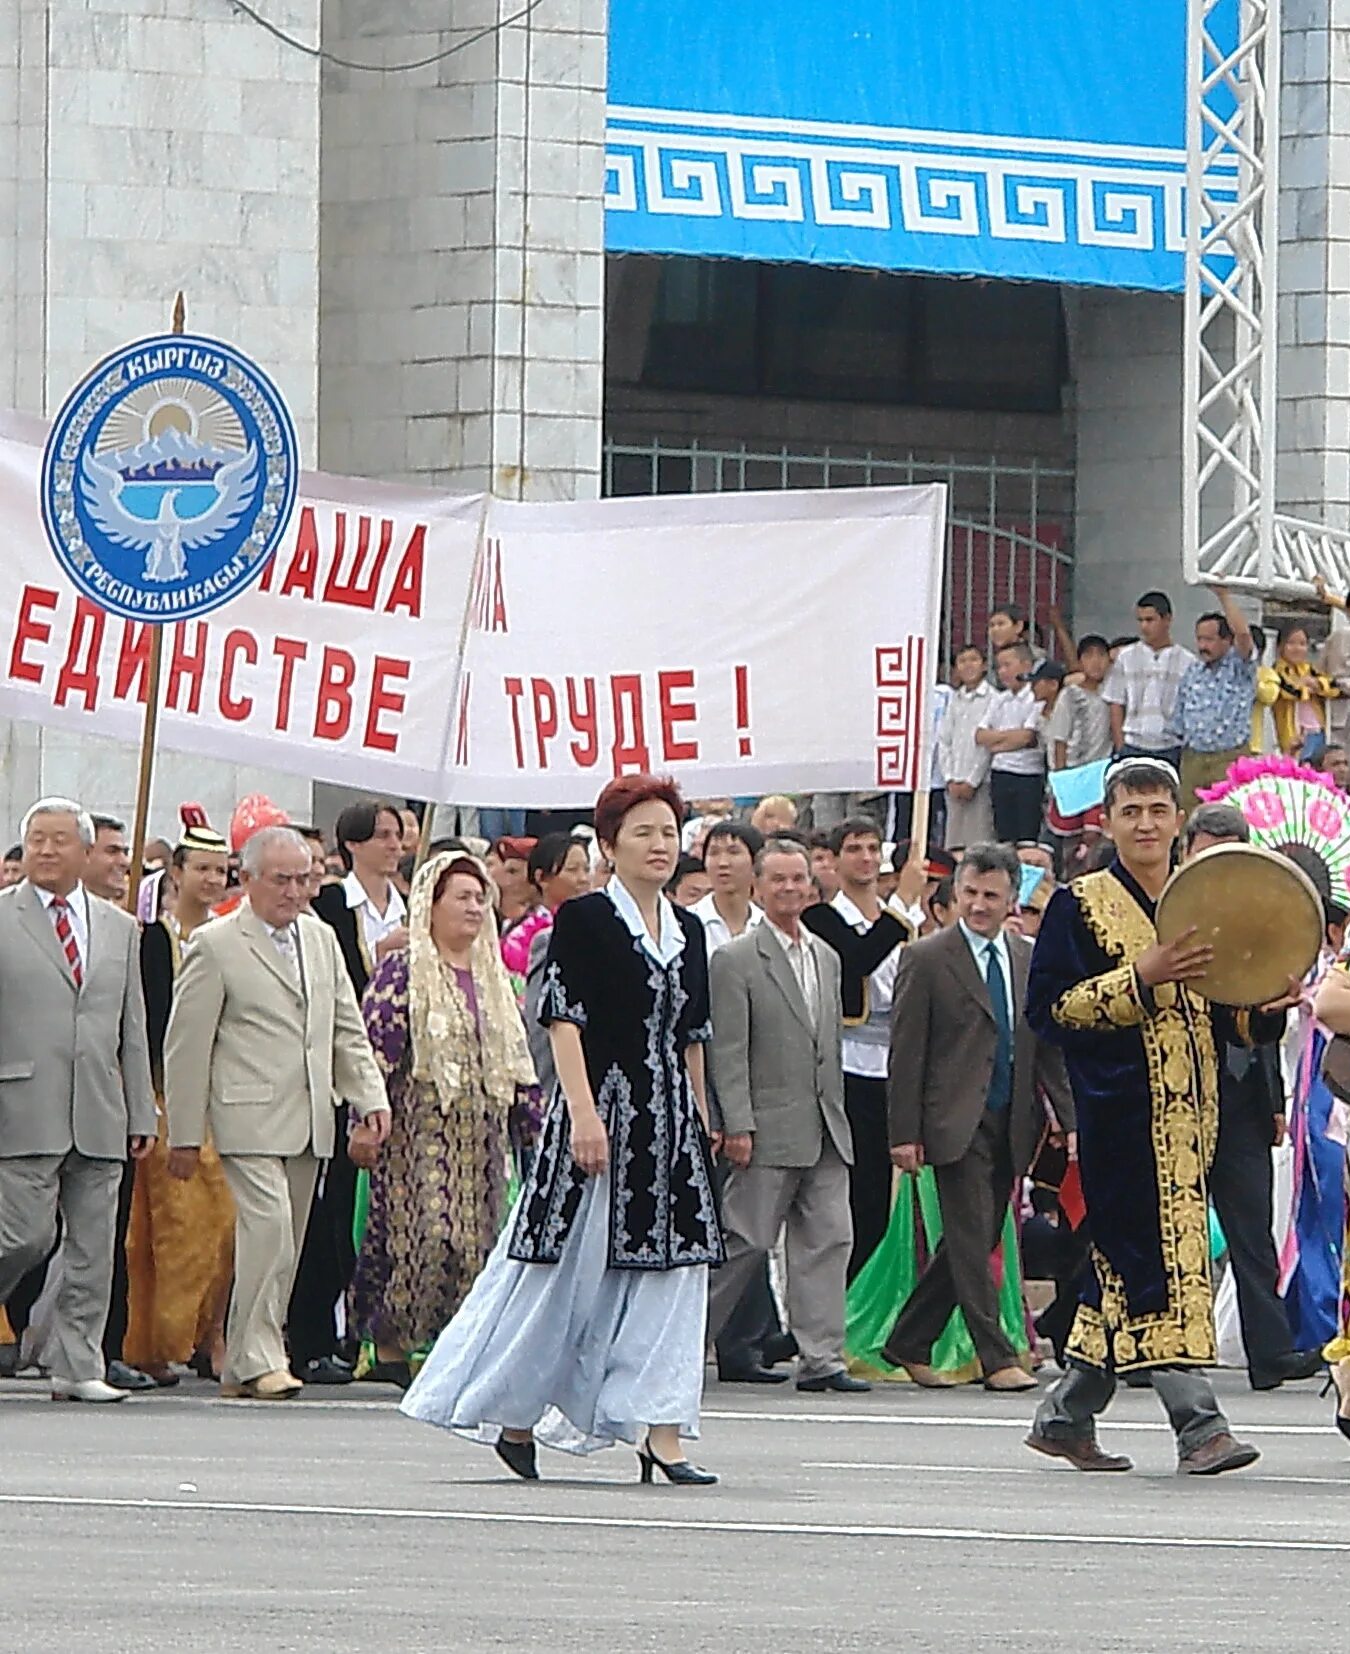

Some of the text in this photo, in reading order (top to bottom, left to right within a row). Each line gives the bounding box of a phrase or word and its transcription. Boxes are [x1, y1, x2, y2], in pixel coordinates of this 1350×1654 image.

[127, 347, 227, 381] КЫРГЫЗ
[84, 556, 247, 613] РЕСПУБЛИКАСЫ
[9, 584, 412, 753] ЕДИНСТВЕ
